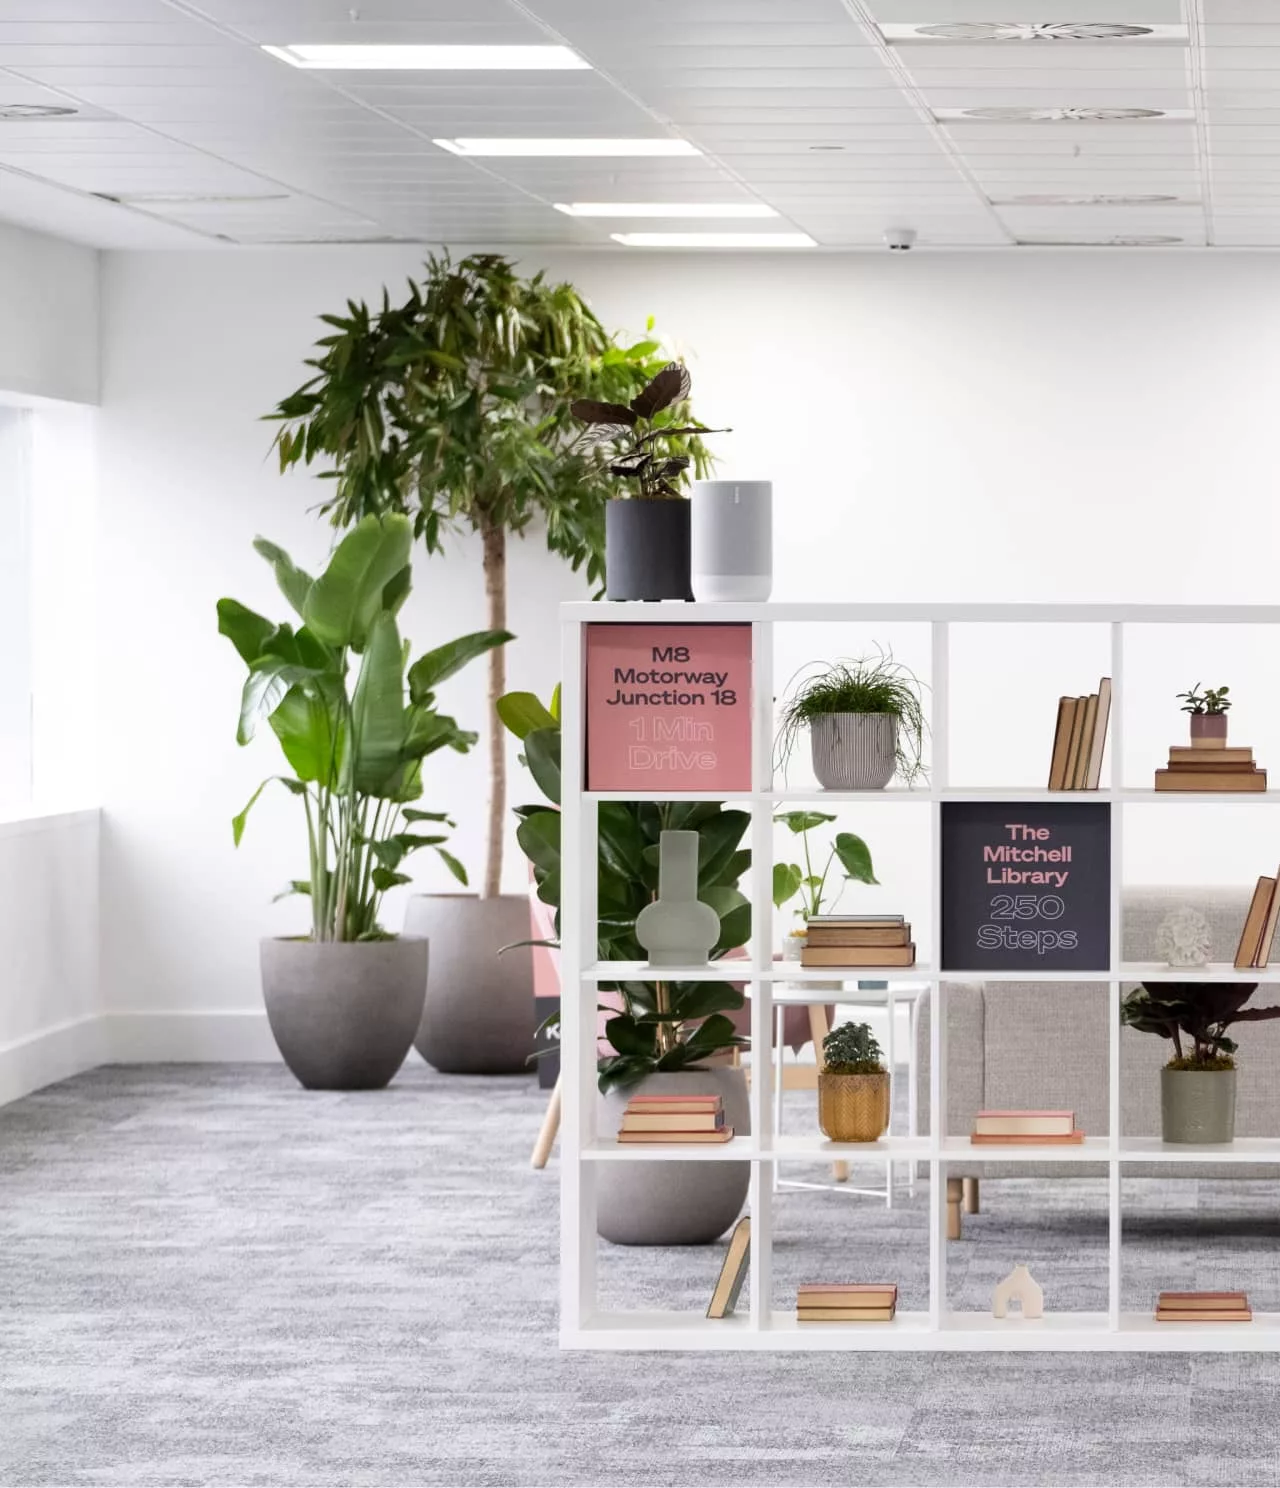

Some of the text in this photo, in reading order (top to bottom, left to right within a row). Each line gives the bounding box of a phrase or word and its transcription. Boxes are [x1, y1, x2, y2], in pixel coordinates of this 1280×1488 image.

[652, 647, 690, 663] M8
[614, 668, 729, 688] Motorway
[606, 690, 737, 706] Junction 18
[629, 717, 713, 741] 1 Min
[629, 746, 717, 770] Drive
[1005, 824, 1050, 841] The
[984, 845, 1072, 863] Mitchell
[987, 867, 1069, 888] Library
[990, 895, 1065, 920] 250
[977, 925, 1078, 955] Steps
